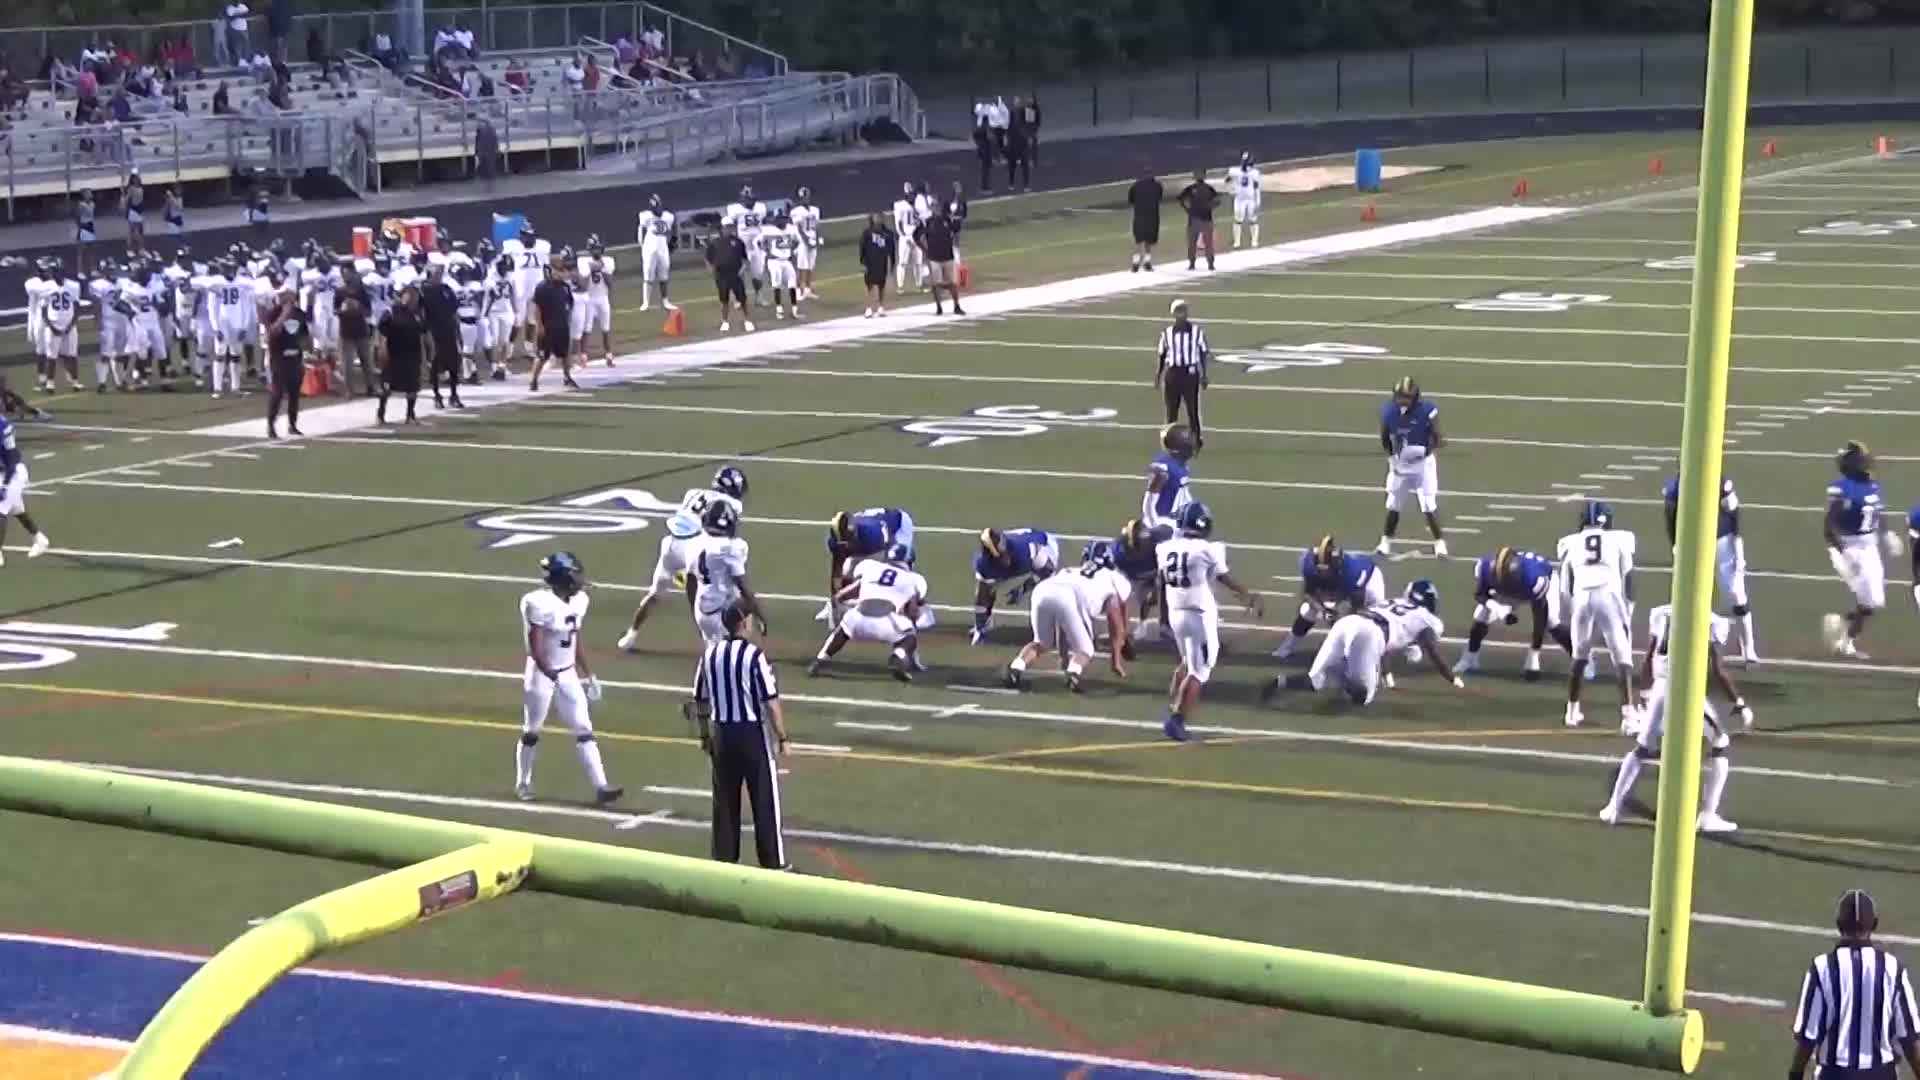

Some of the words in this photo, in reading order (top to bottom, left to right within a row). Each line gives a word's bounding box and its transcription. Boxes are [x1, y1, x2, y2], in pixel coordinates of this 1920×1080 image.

[520, 252, 541, 268] 71
[50, 291, 71, 311] 26
[902, 405, 1118, 436] 30
[1585, 534, 1602, 566] 9
[879, 568, 898, 586] 8
[1167, 551, 1190, 587] 21
[560, 614, 577, 648] 3
